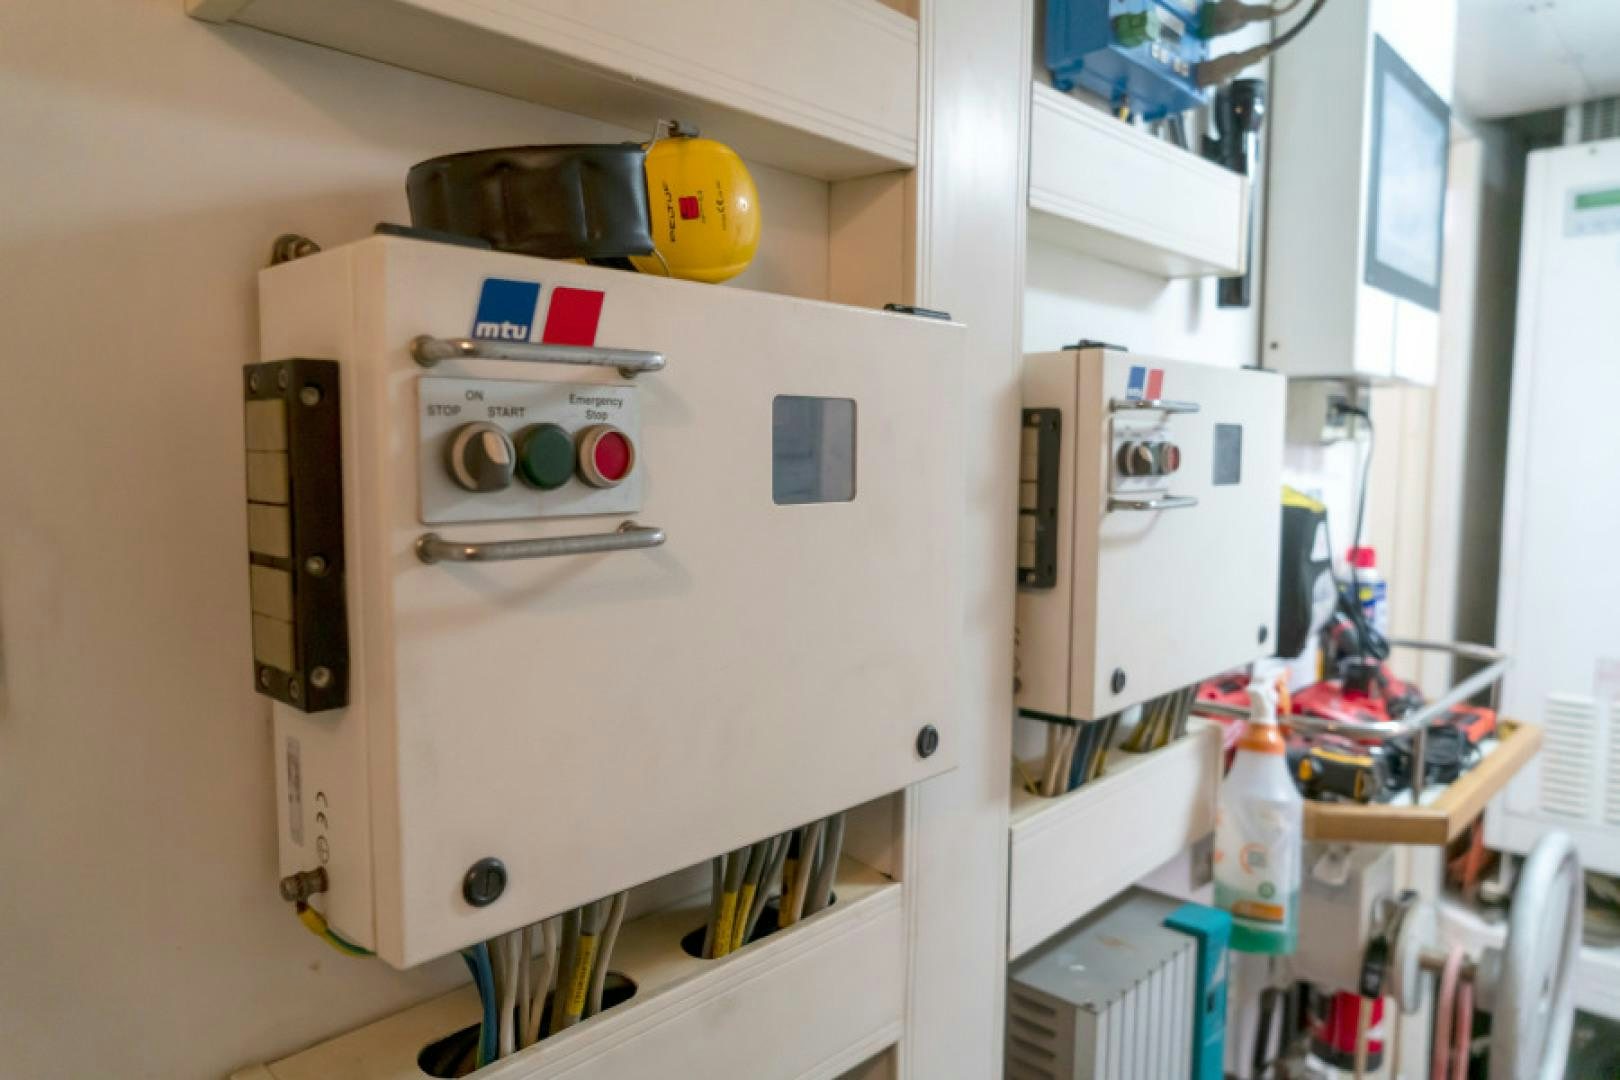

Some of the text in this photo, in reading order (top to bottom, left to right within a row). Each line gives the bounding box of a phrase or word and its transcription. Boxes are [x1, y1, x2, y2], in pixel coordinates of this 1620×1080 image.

[477, 320, 528, 339] mtu
[465, 390, 484, 401] ON
[568, 393, 623, 408] Emergency
[427, 405, 461, 417] STOP
[487, 406, 527, 418] START
[585, 409, 609, 421] Stop
